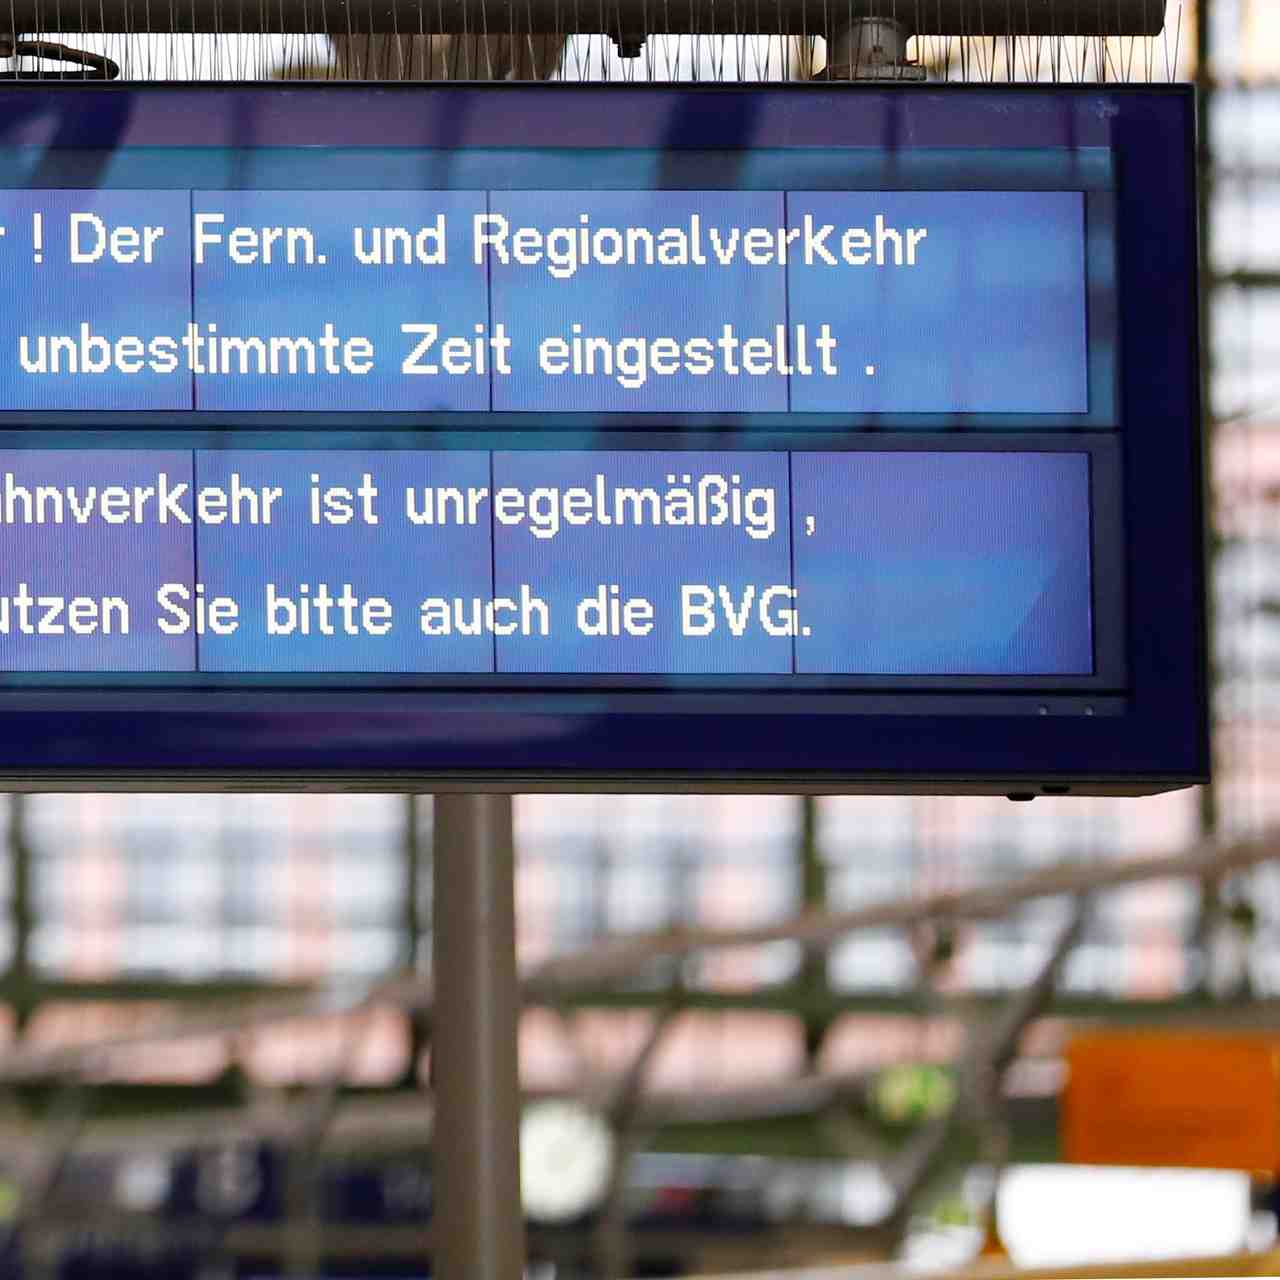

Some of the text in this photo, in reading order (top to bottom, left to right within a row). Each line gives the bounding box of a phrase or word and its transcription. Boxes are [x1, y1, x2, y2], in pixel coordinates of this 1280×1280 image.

[33, 212, 42, 263] !
[70, 212, 164, 264] Der
[195, 213, 326, 264] Fern.
[354, 214, 446, 265] und
[473, 213, 927, 279] Regionalverkehr
[19, 322, 374, 374] unbestimmte
[401, 323, 512, 375] Zeit
[539, 324, 837, 389] eingestellt
[311, 473, 378, 525] ist
[406, 474, 775, 539] unregelmäßig
[157, 583, 239, 635] Sie
[266, 583, 393, 635] bitte
[420, 584, 549, 636] auch
[576, 584, 654, 636] die
[681, 584, 811, 636] BVG.
